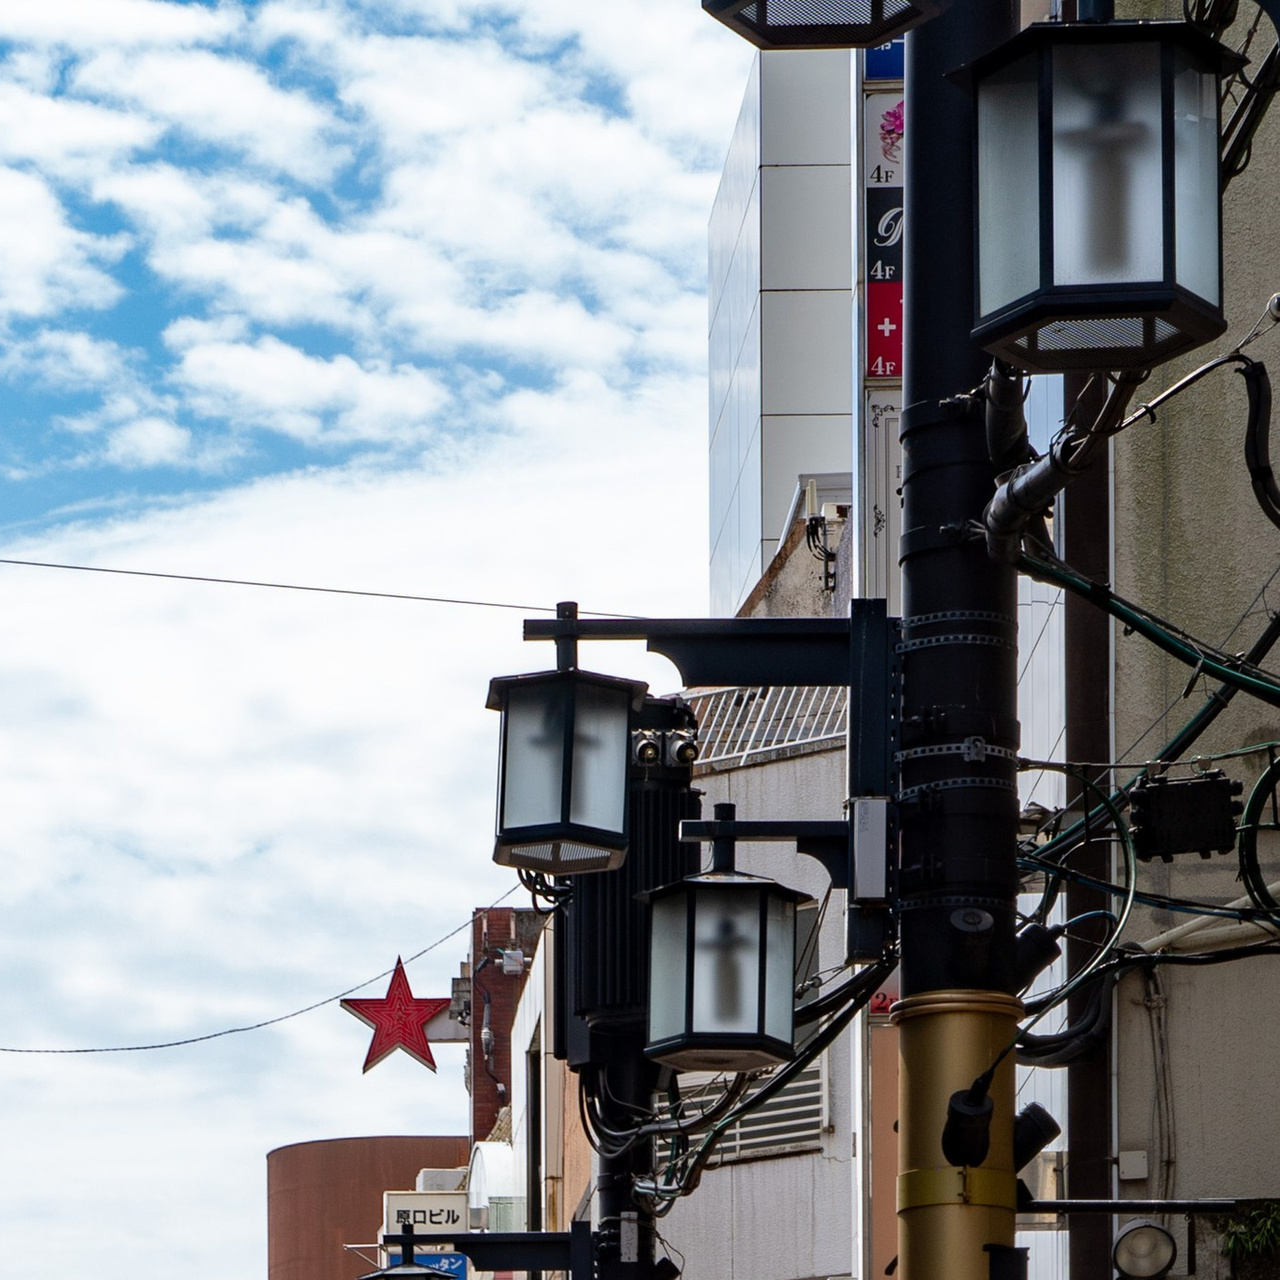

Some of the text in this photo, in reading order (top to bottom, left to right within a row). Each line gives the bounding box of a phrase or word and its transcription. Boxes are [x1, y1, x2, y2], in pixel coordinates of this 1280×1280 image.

[870, 166, 895, 184] 4F
[870, 260, 896, 280] 4F
[870, 356, 896, 376] 4F
